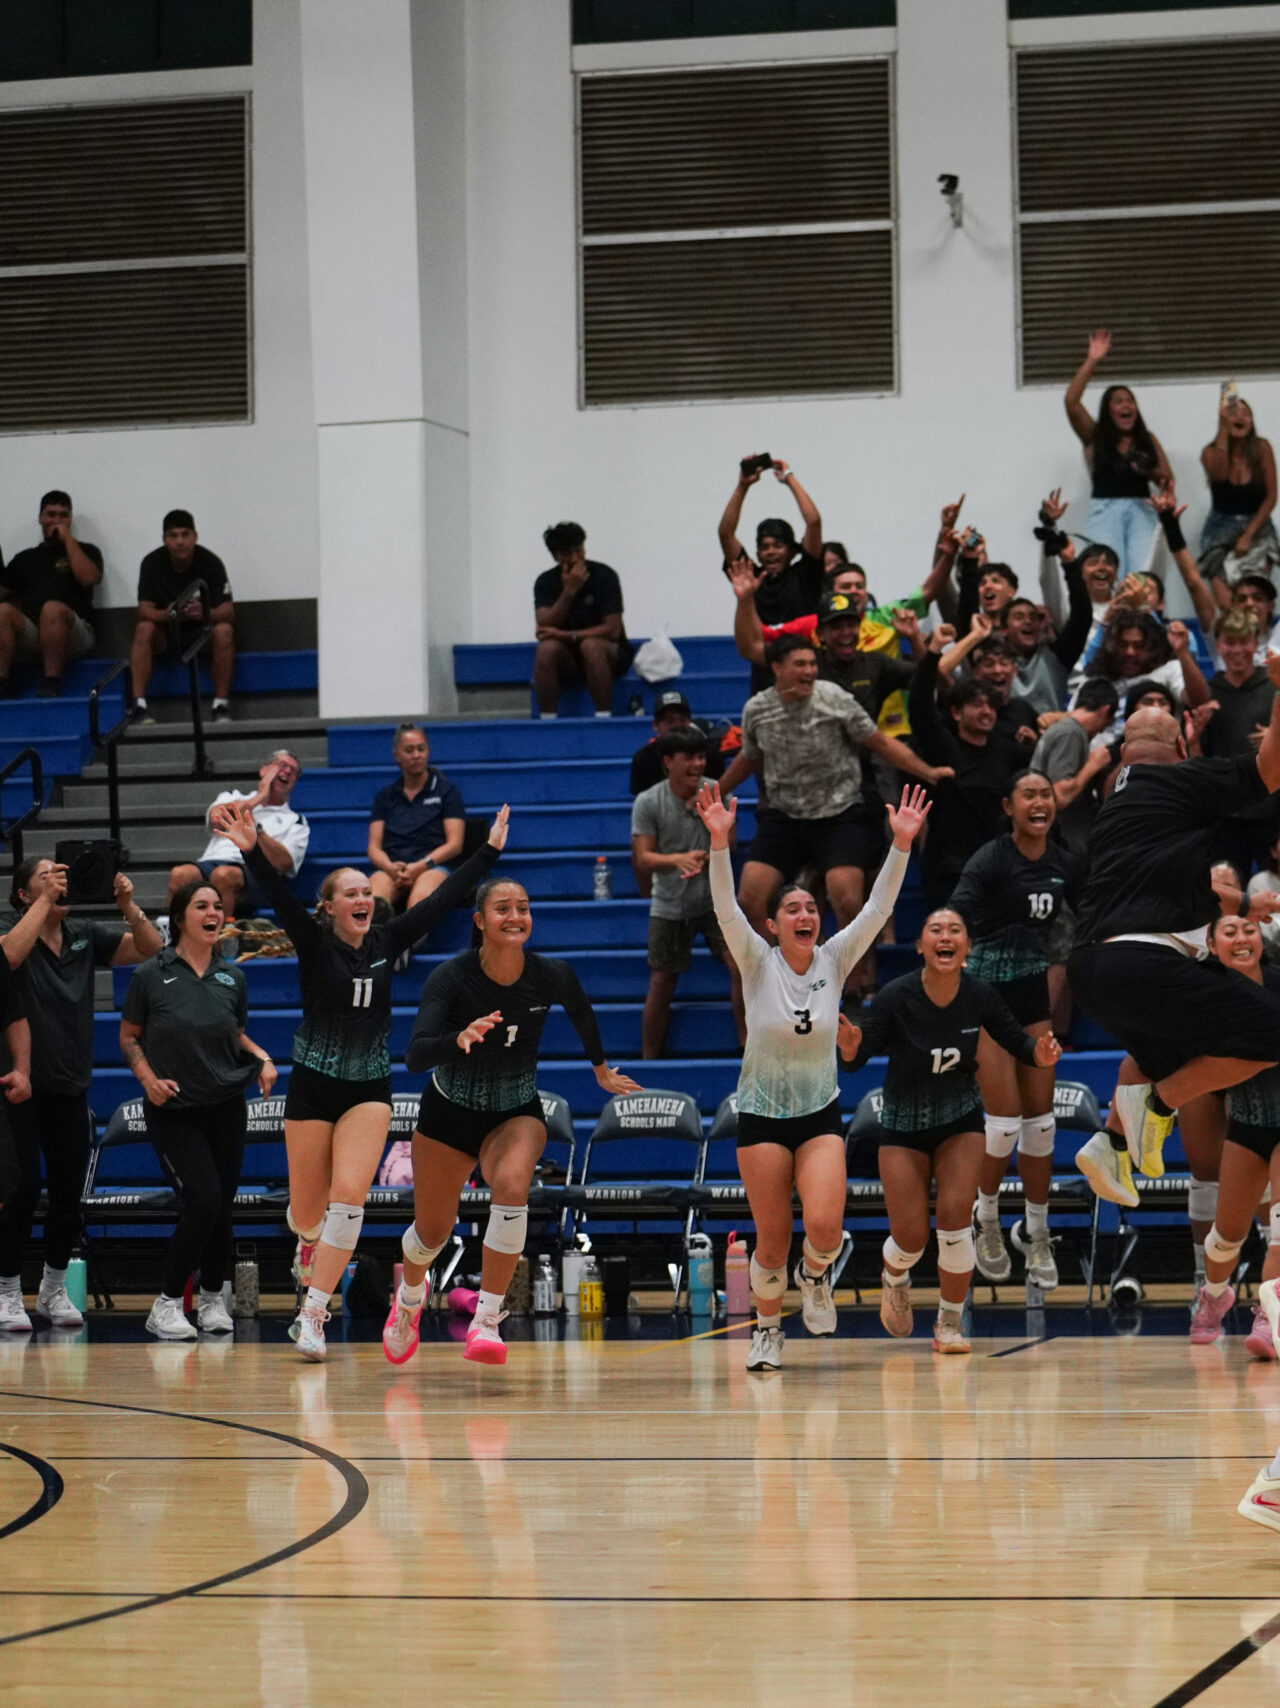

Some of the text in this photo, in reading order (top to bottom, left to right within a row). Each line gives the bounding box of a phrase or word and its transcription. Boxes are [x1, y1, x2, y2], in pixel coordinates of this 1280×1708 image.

[1027, 892, 1054, 920] 10
[352, 978, 373, 1008] 11
[794, 1009, 813, 1035] 3
[930, 1047, 962, 1074] 12
[614, 1097, 686, 1117] KAMEHAMEHA
[620, 1116, 677, 1128] SCHOOLS MAUI
[585, 1189, 642, 1200] WARRIORS
[1136, 1179, 1190, 1191] WARRIOR
